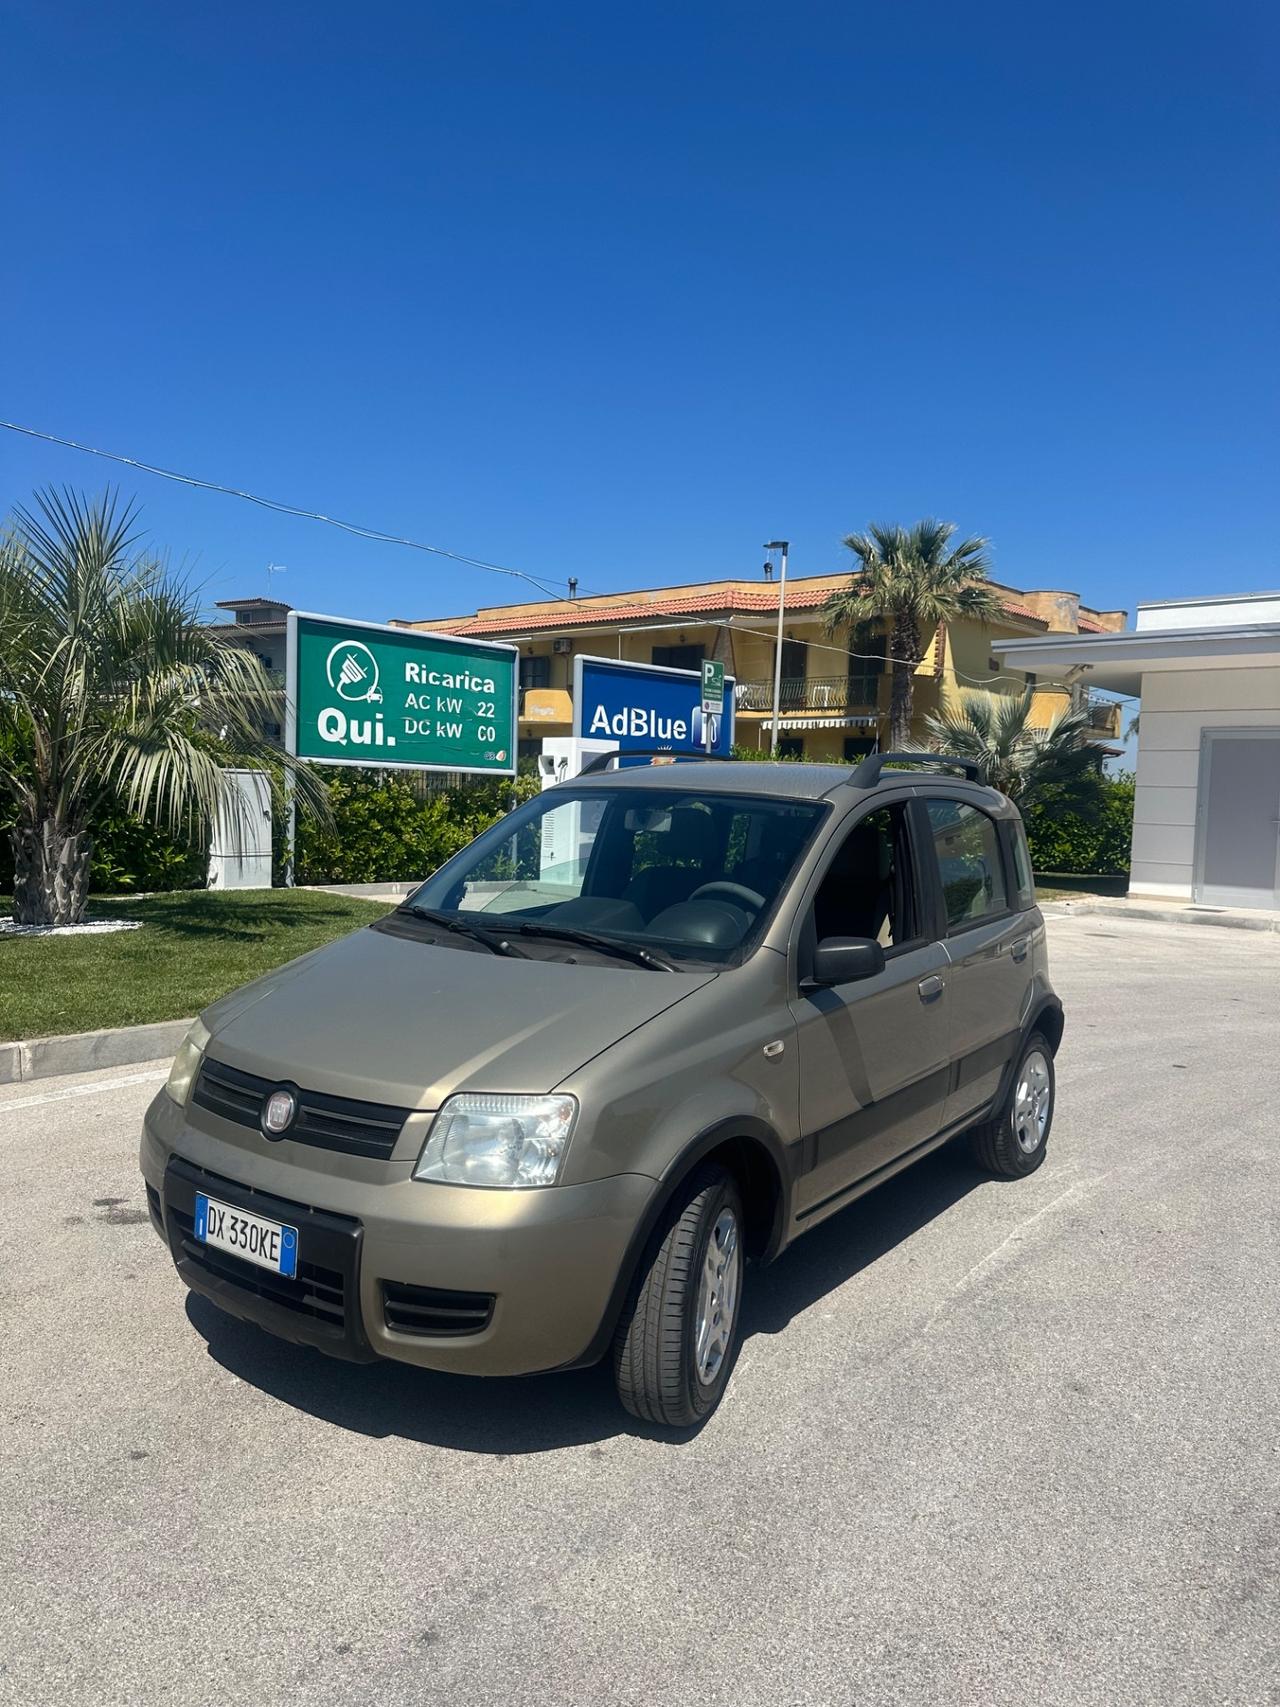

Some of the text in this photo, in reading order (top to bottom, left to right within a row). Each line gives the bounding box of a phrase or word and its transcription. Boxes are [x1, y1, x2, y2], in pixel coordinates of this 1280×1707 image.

[405, 662, 495, 693] Ricarica
[704, 663, 715, 684] P
[404, 692, 495, 718] AC kW 22
[317, 707, 396, 747] Qui.
[404, 719, 431, 735] DC
[436, 721, 463, 739] kW
[589, 704, 687, 740] AdBlue
[208, 1206, 280, 1262] DX 330KE
